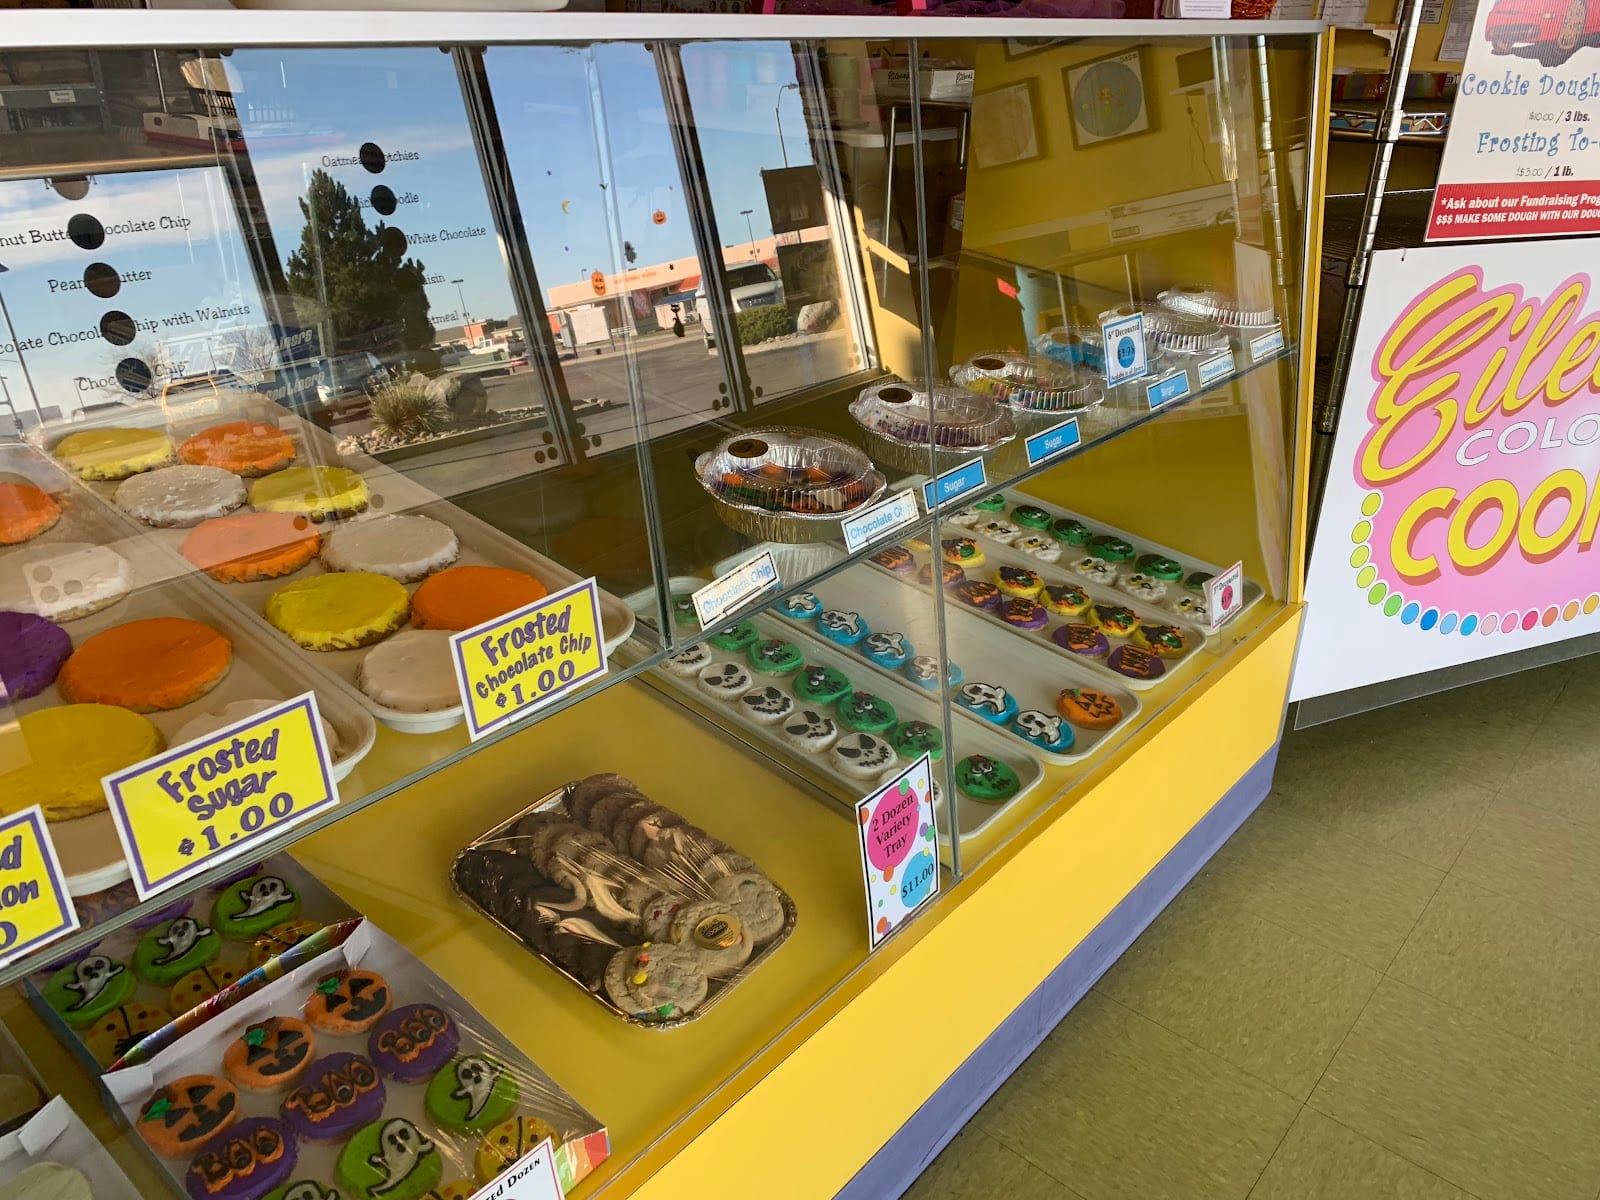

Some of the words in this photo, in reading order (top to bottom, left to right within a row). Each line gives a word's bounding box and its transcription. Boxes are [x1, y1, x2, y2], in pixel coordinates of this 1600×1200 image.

[1462, 70, 1530, 96] Cookie
[1539, 72, 1600, 101] Dough
[1565, 110, 1571, 122] 3
[1573, 110, 1590, 122] lbs.
[1477, 132, 1560, 157] Frosting
[1569, 127, 1600, 151] To-
[1553, 166, 1560, 177] 1
[1562, 166, 1574, 177] lb.
[1455, 212, 1480, 224] MAKE
[1481, 211, 1506, 223] SOME
[1508, 210, 1538, 222] DOUGH
[1540, 209, 1561, 221] WITH
[1562, 209, 1579, 220] OUR
[1469, 196, 1500, 209] about
[1501, 197, 1519, 207] our
[1520, 195, 1579, 208] Fundraising
[159, 215, 191, 231] Chip
[406, 232, 438, 246] White
[439, 226, 487, 242] Chocolate
[135, 318, 159, 334] hip
[162, 311, 194, 327] with
[195, 305, 251, 321] Walnuts
[1361, 273, 1600, 485] Eile
[1044, 434, 1063, 451] Sugar
[944, 476, 966, 494] Sugar
[850, 512, 893, 540] Chocolate
[750, 564, 772, 584] Chip
[481, 604, 572, 666] Frosted
[475, 645, 554, 699] Chocolate
[559, 632, 592, 655] Chip
[495, 659, 575, 709] $1.00
[157, 728, 280, 804] Frosted
[187, 771, 277, 821] Sugar
[178, 792, 294, 856] $1.00
[872, 819, 880, 833] 2
[881, 794, 914, 826] Dozen
[875, 812, 914, 846] Variety
[883, 833, 908, 859] Tray
[901, 863, 935, 899] $11.00
